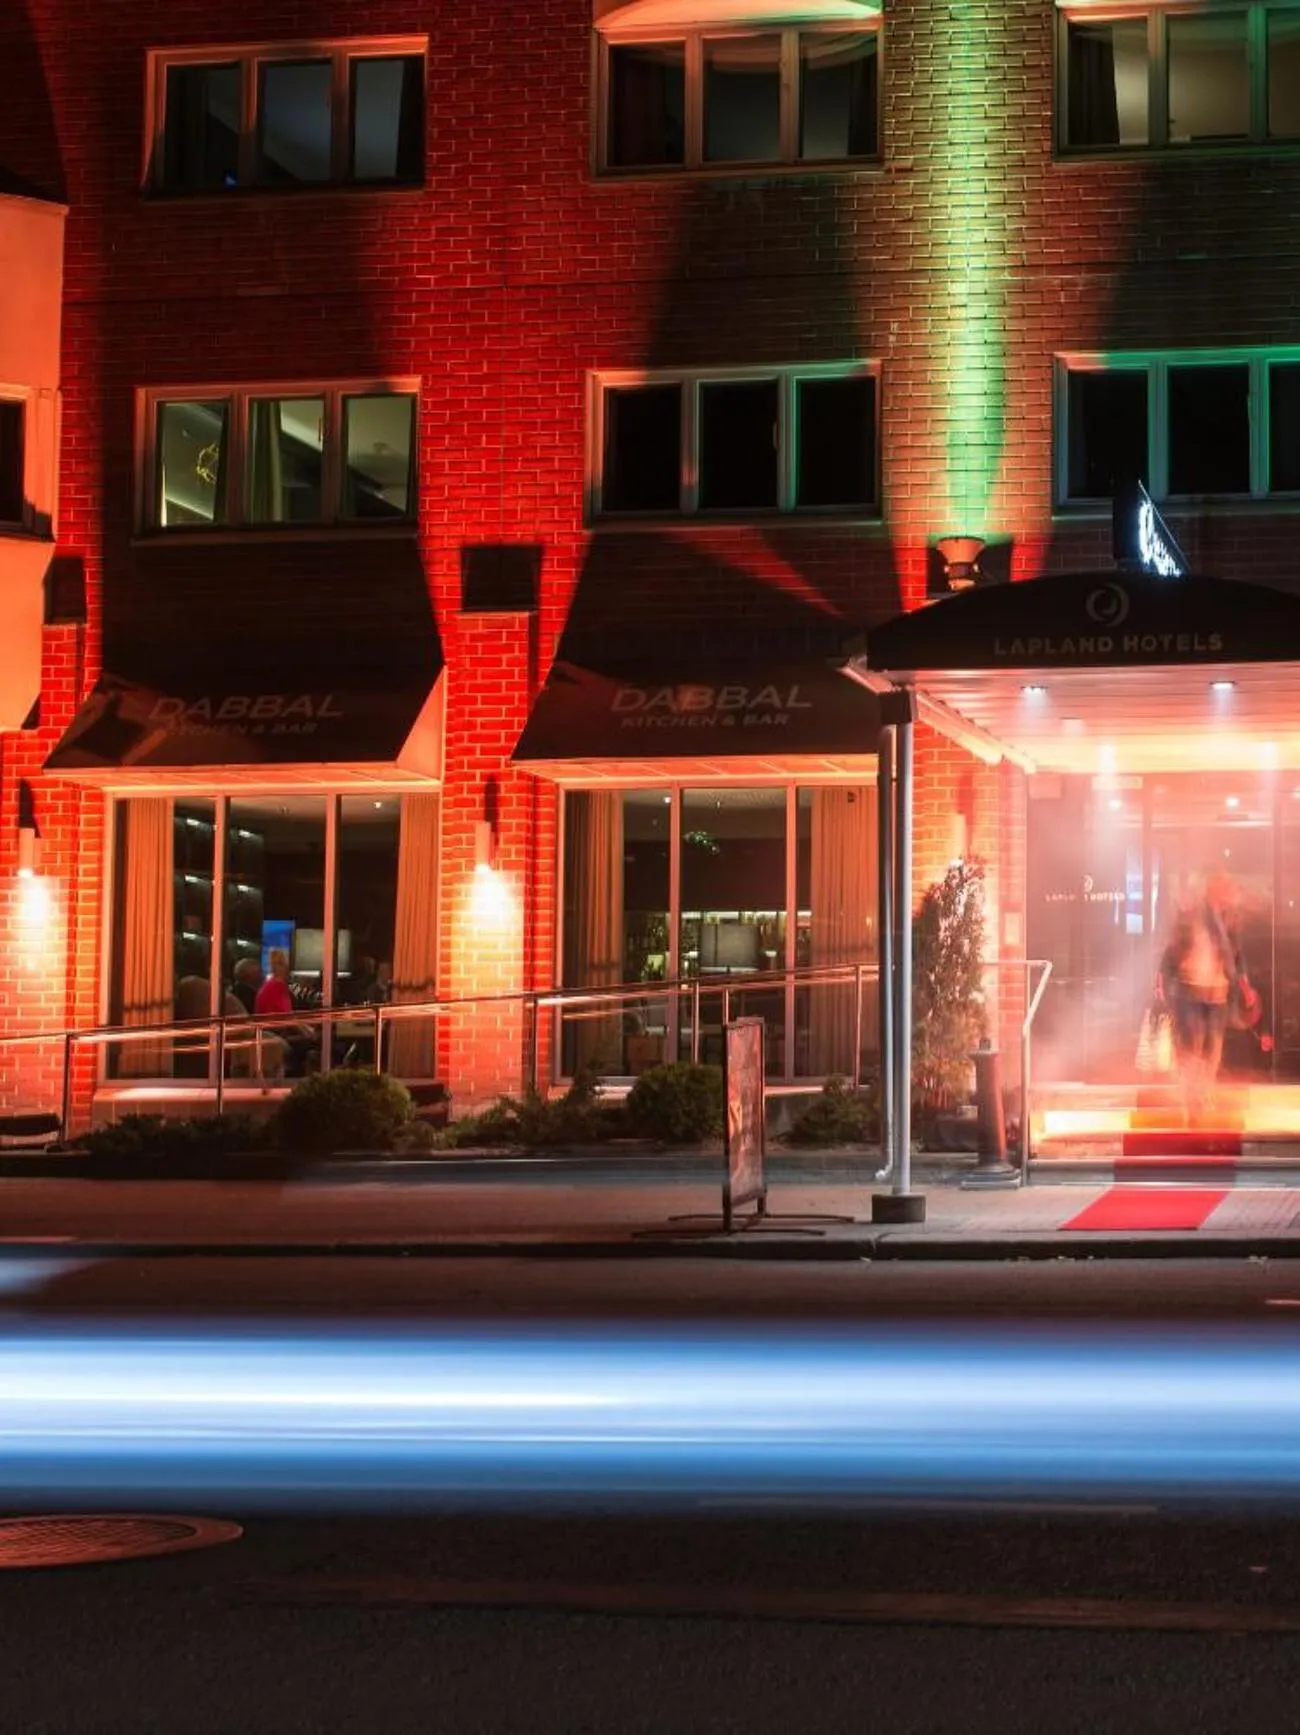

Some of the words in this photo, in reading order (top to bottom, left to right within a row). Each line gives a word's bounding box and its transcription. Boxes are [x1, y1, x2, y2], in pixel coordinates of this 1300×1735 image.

[994, 636, 1114, 656] LAPLAND
[1123, 633, 1224, 653] HOTELS
[148, 694, 344, 719] DABBAL
[610, 684, 813, 711] DABBAL
[620, 714, 716, 729] KITCHEN
[721, 714, 736, 727] &
[744, 713, 790, 727] BAR
